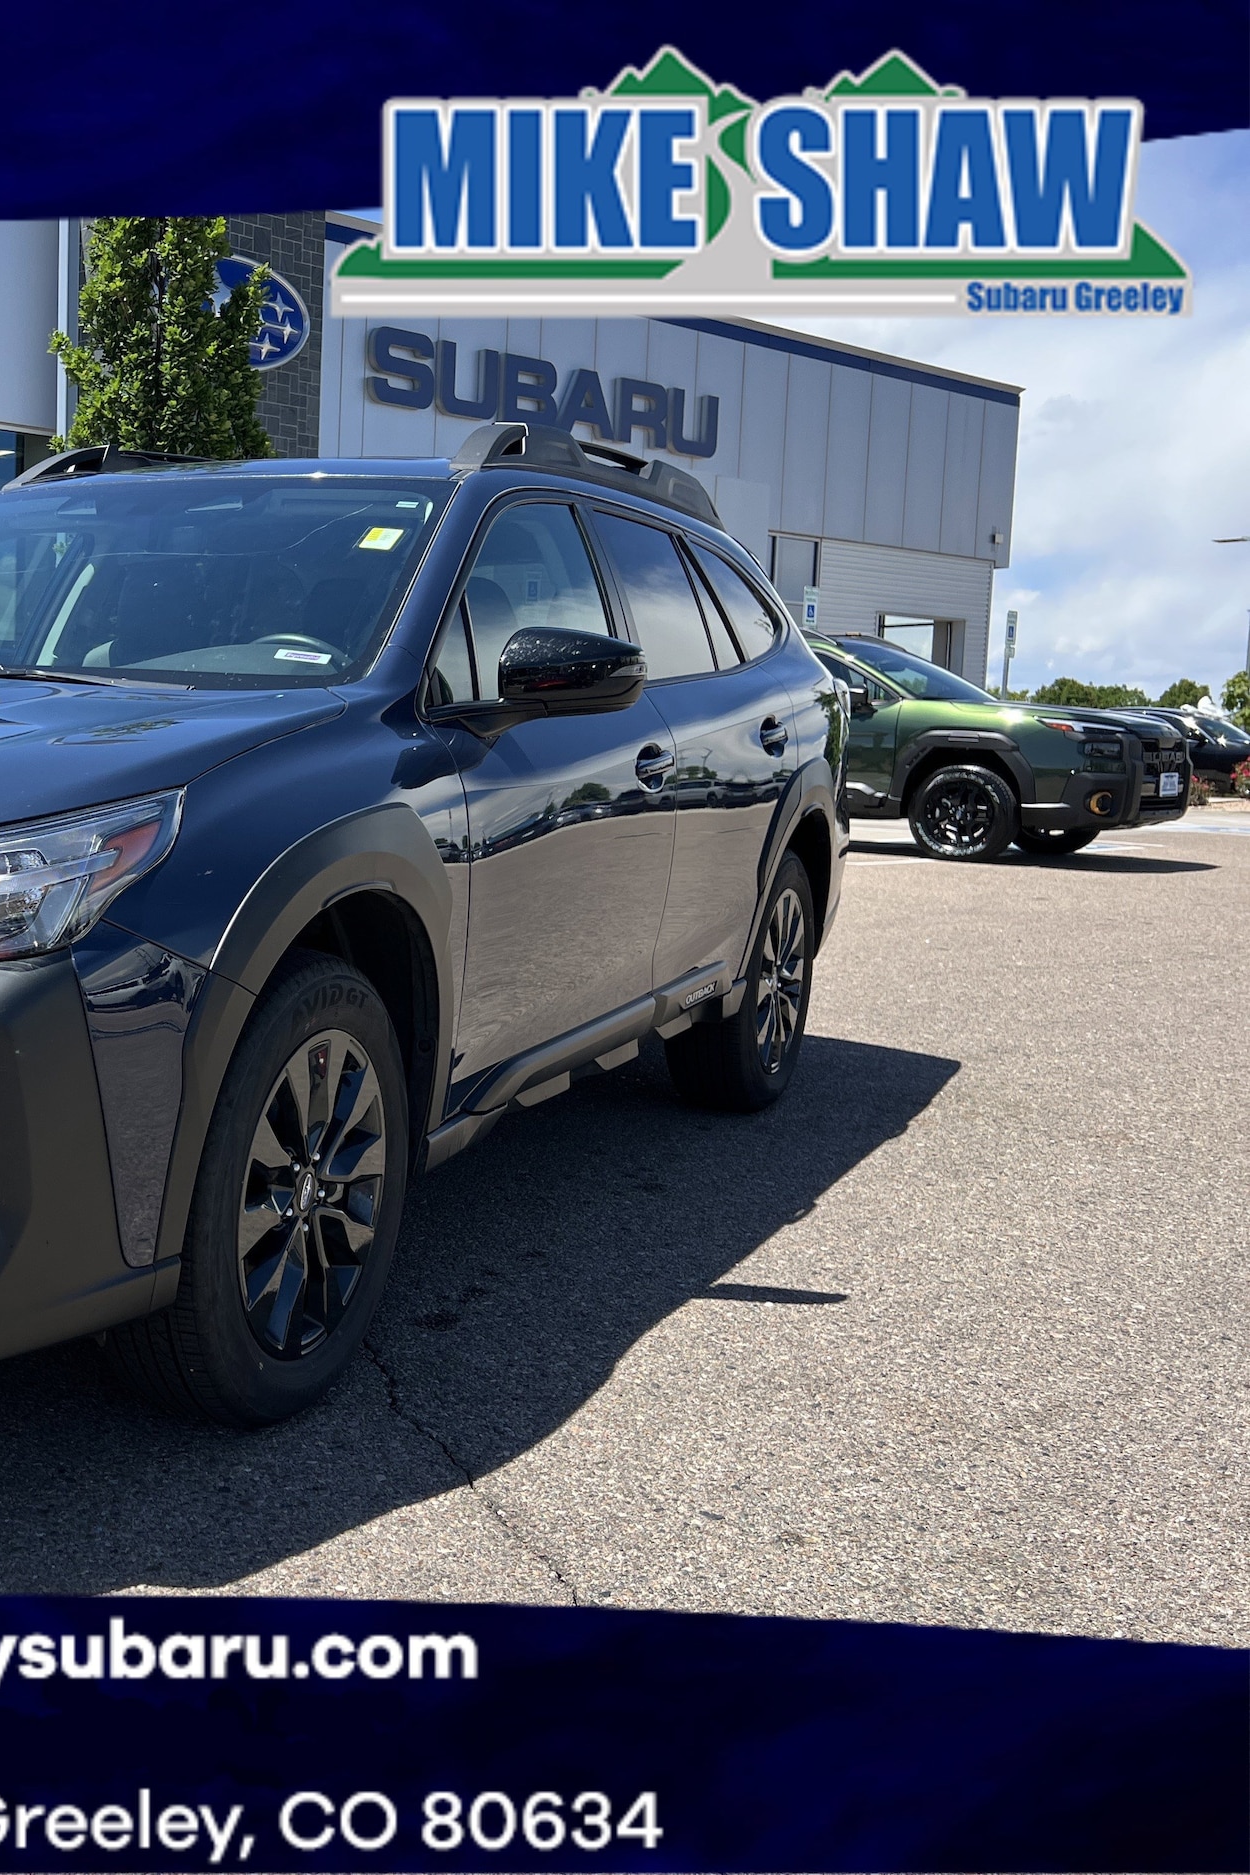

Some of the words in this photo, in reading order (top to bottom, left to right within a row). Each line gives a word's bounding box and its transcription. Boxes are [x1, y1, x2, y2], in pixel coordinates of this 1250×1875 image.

[365, 325, 720, 459] SUBARU
[346, 987, 369, 1009] GT
[685, 982, 716, 1005] OUTBACK
